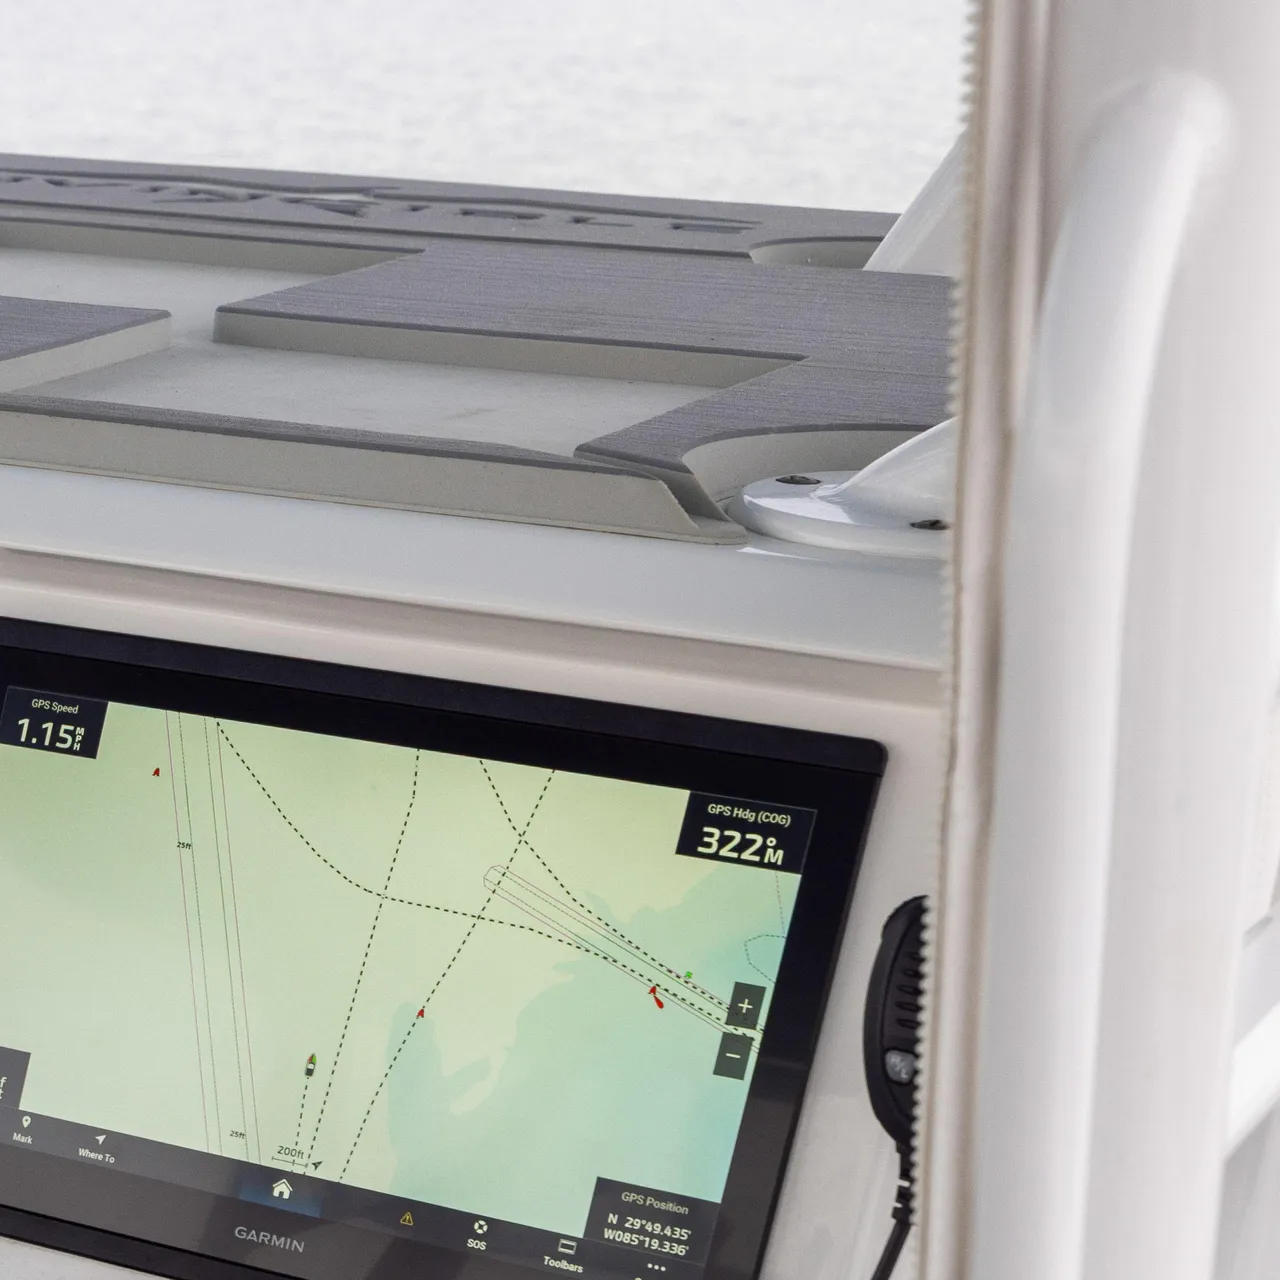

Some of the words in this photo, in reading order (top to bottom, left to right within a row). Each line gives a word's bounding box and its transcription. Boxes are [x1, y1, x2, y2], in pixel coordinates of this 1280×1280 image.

[31, 698, 51, 711] GPS
[51, 701, 80, 715] Speed
[16, 717, 74, 750] 1.15
[707, 802, 732, 817] GPS
[732, 805, 756, 823] Hdg
[756, 809, 792, 828] (COG)
[176, 840, 193, 851] 25ft
[696, 826, 762, 863] 322
[12, 1131, 34, 1145] Mark
[78, 1146, 103, 1163] Where
[103, 1152, 116, 1165] To
[276, 1145, 306, 1160] 200ft
[621, 1191, 645, 1206] GPS
[645, 1195, 690, 1216] Position
[607, 1213, 618, 1226] N
[233, 1226, 305, 1254] GARMIN
[466, 1238, 487, 1251] SOS
[543, 1255, 584, 1274] Toolbars
